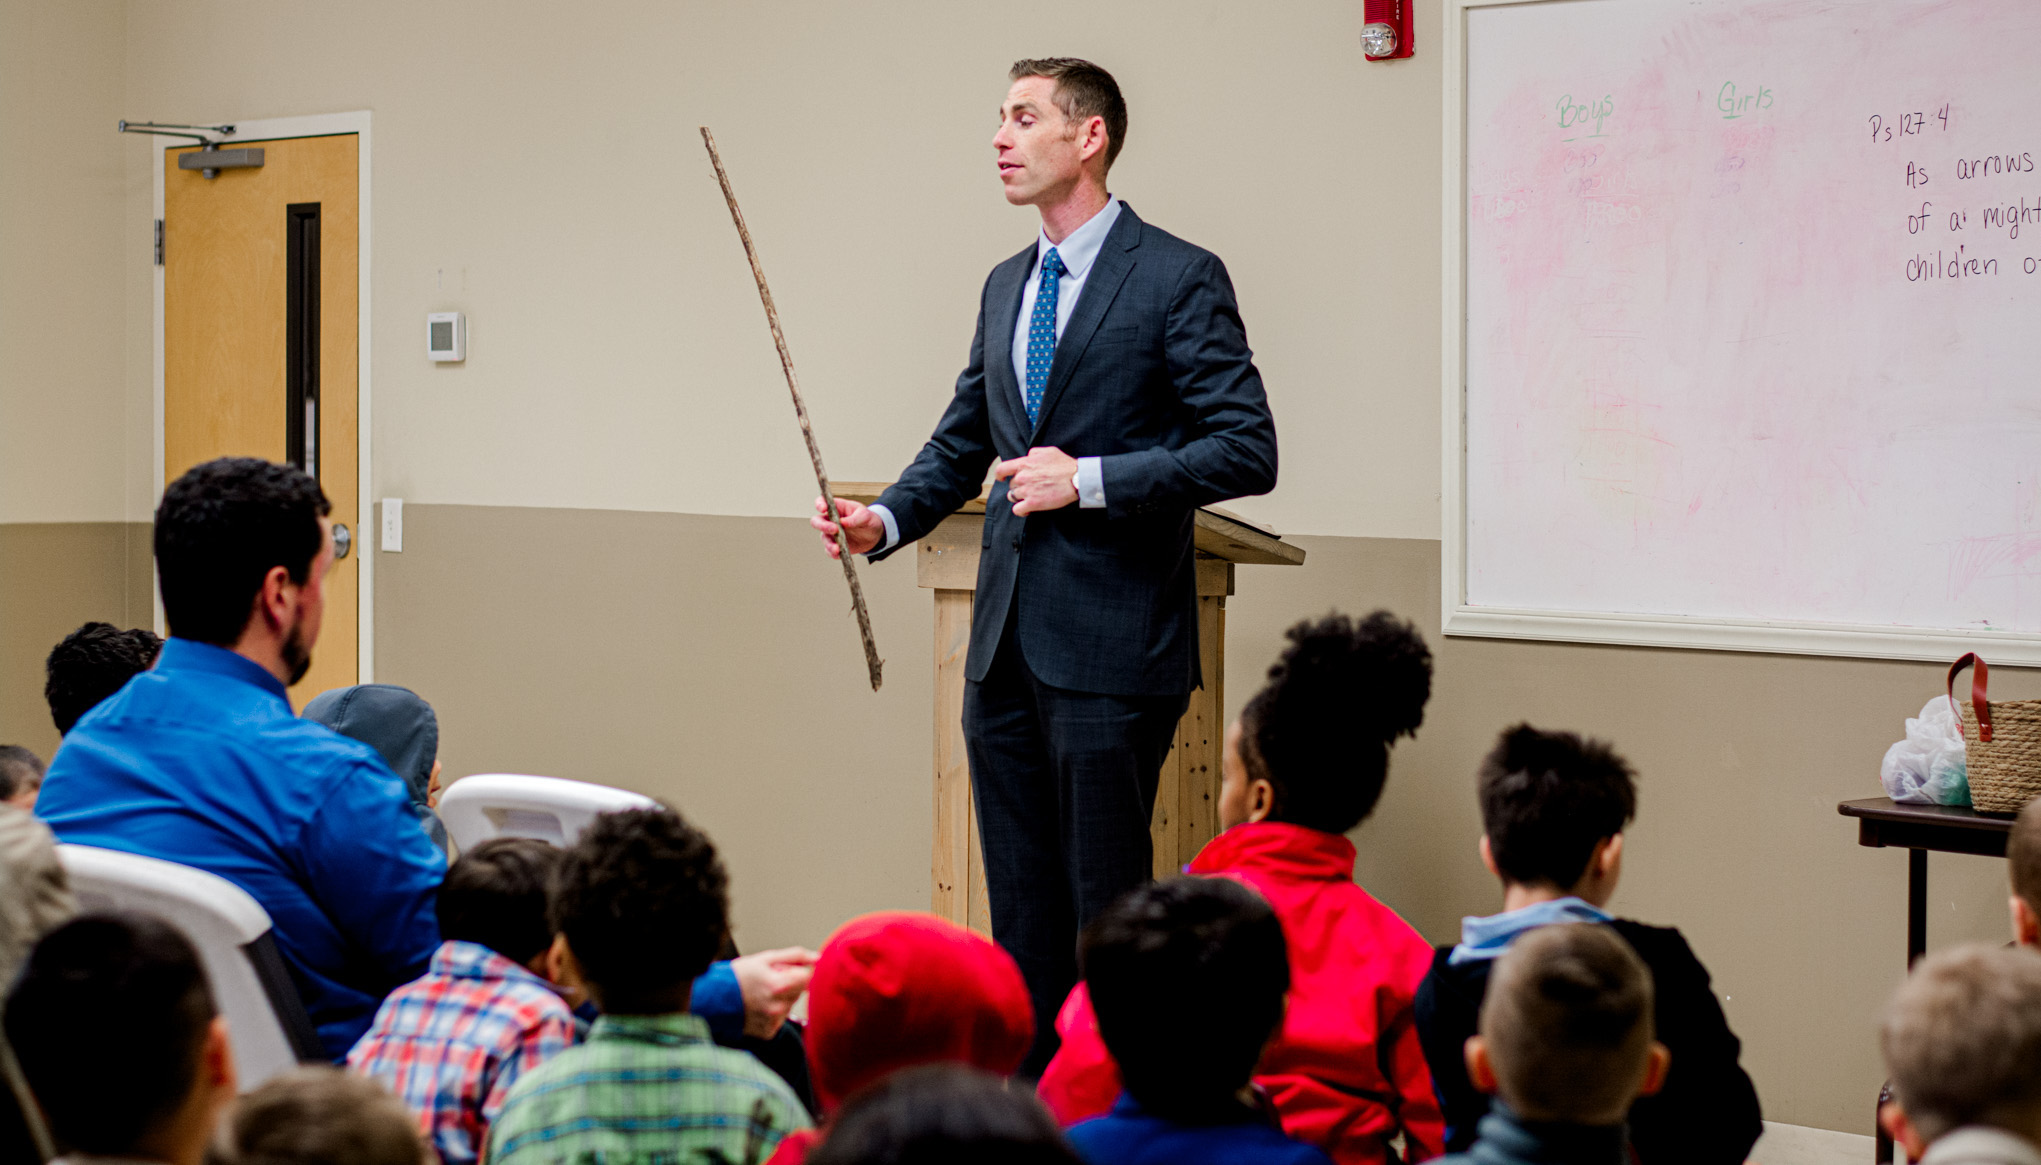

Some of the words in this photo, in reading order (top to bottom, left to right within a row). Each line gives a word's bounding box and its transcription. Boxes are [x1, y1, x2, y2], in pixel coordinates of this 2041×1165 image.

[1555, 94, 1614, 135] Boys
[1717, 80, 1774, 115] Girls
[1868, 114, 1893, 143] Ps
[1906, 160, 1930, 189] As
[1956, 152, 2035, 180] arrows
[1907, 201, 1933, 235] of
[1906, 250, 1998, 282] children
[2023, 256, 2041, 275] o
